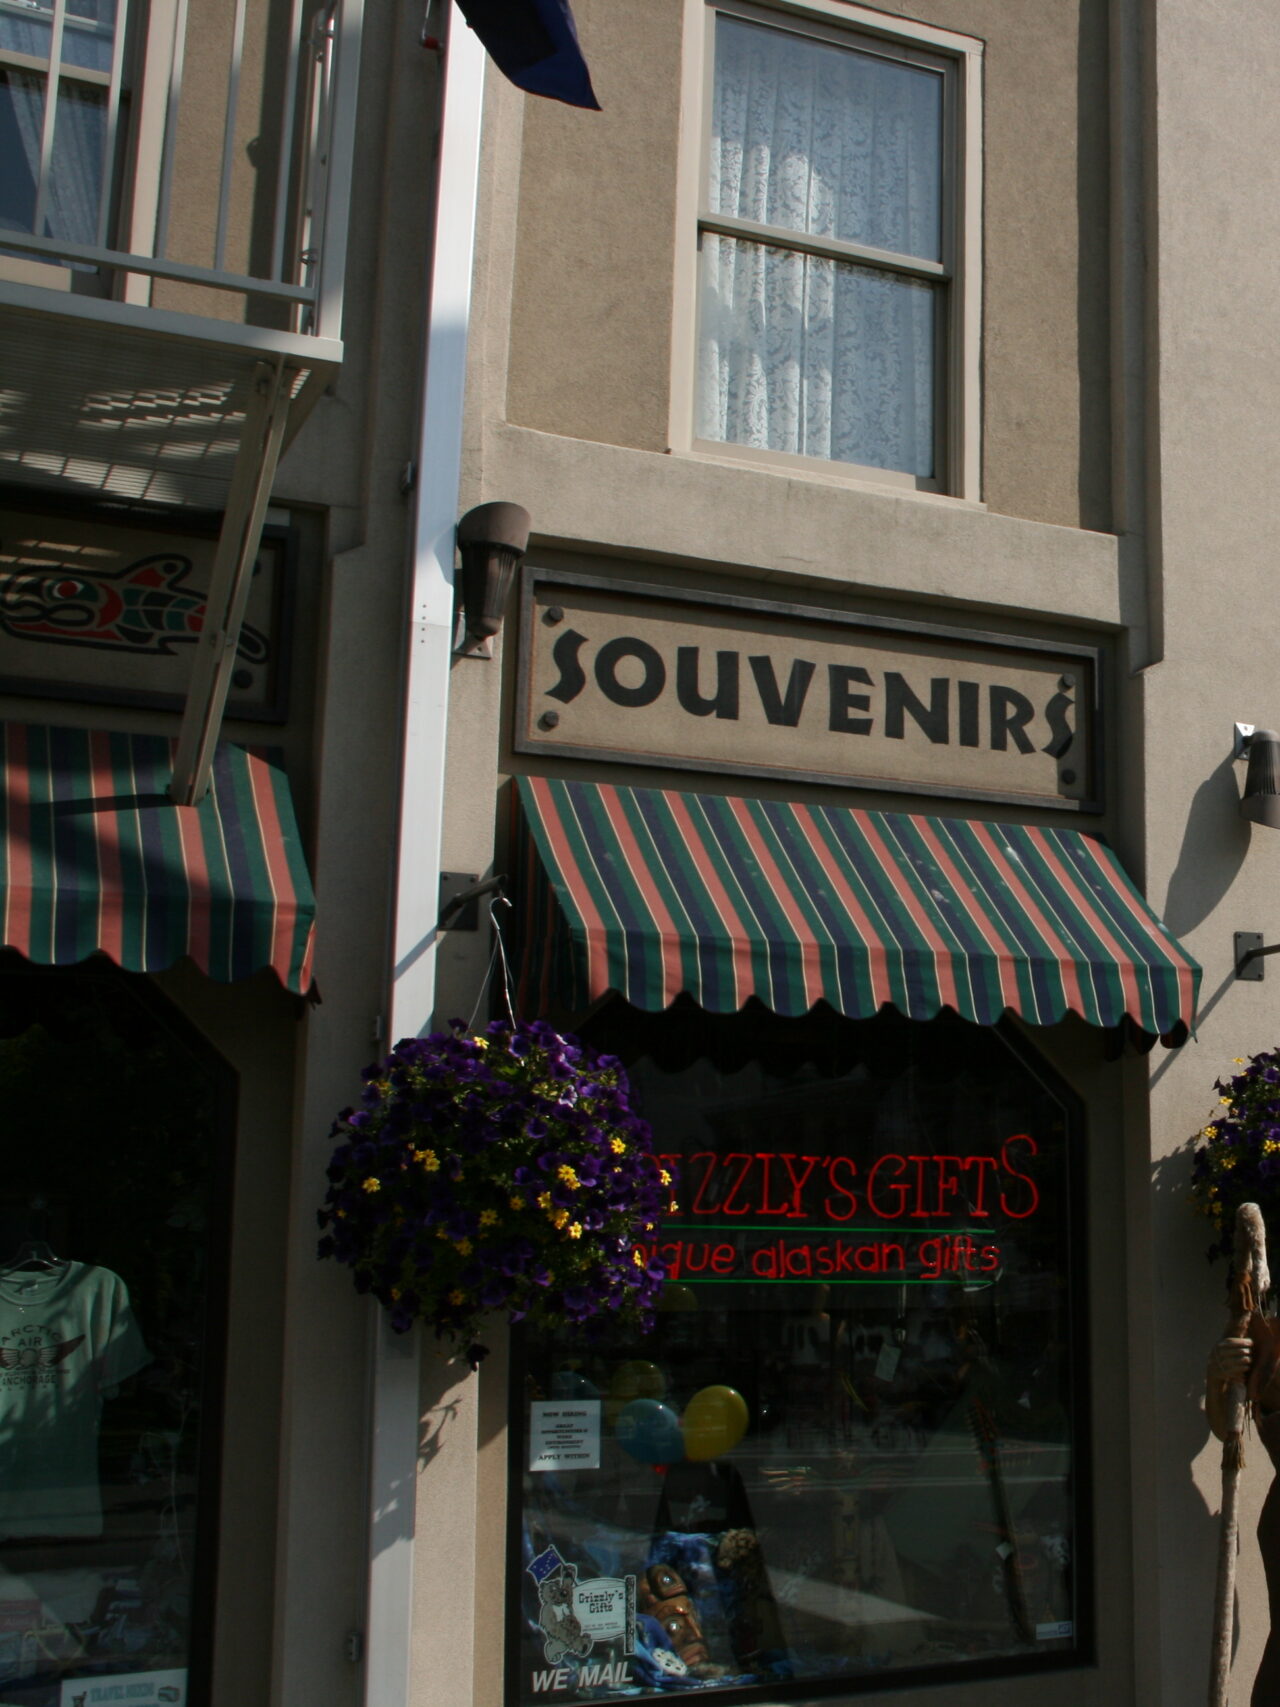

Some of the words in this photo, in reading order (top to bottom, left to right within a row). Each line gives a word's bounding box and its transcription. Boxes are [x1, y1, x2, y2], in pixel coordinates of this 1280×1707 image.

[544, 629, 1076, 759] SOUVENIRS
[640, 1152, 858, 1221] IZZLY'S
[866, 1134, 1040, 1219] GIFTS
[630, 1237, 735, 1280] nique
[751, 1238, 906, 1279] alaskan
[917, 1234, 1002, 1280] gifts
[18, 1336, 43, 1348] AIR
[579, 1590, 624, 1604] Grizzly's
[590, 1602, 613, 1613] Gifts
[531, 1668, 570, 1693] WE
[578, 1661, 634, 1689] MAIL
